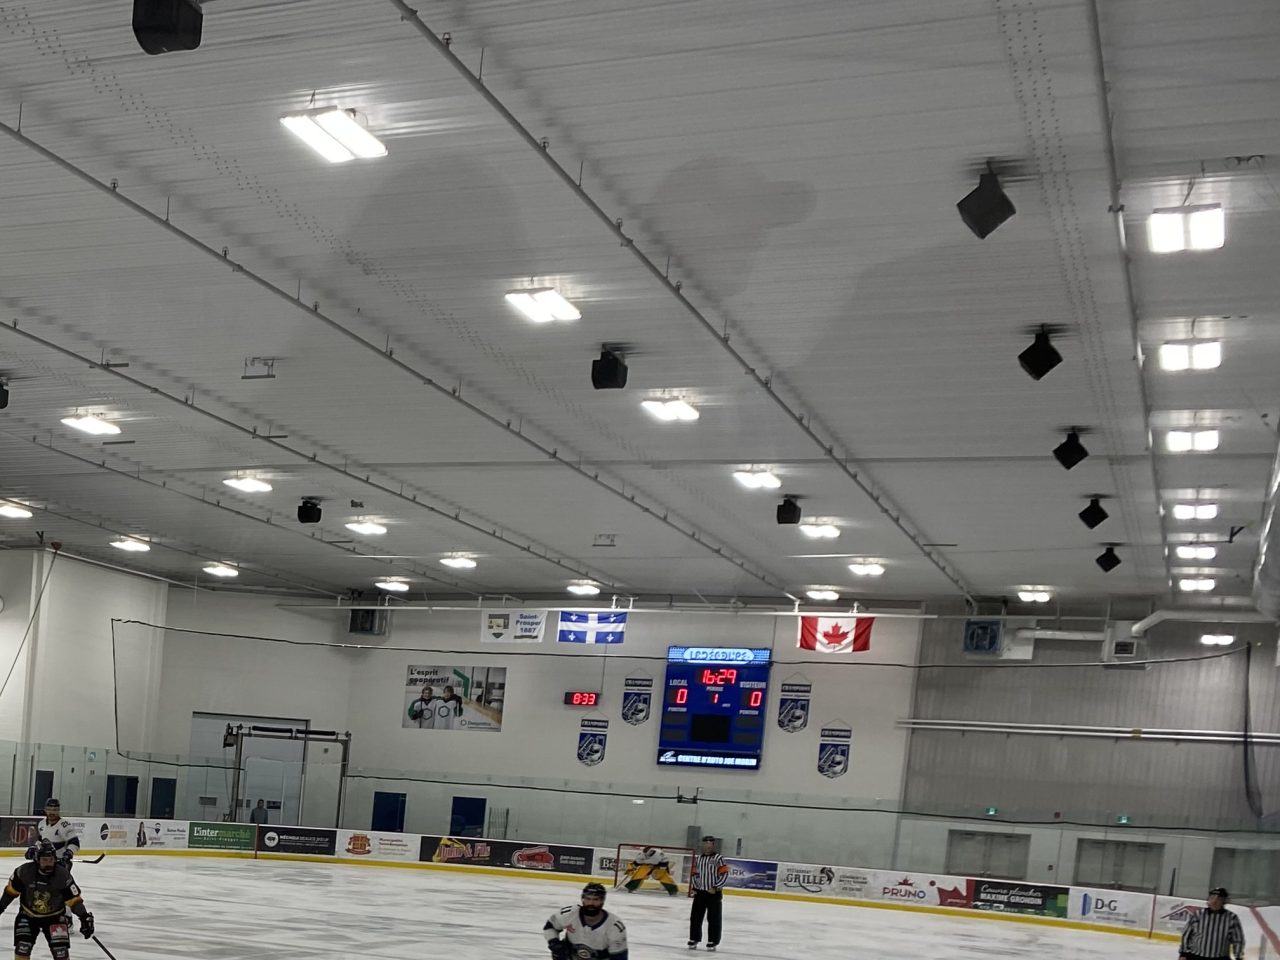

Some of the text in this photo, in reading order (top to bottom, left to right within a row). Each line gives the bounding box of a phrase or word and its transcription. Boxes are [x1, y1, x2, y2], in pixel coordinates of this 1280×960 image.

[572, 693, 596, 705] 8:33
[676, 689, 688, 704] 0
[750, 691, 762, 707] 0
[786, 873, 825, 886] GRILLE
[882, 886, 926, 899] PRUNO
